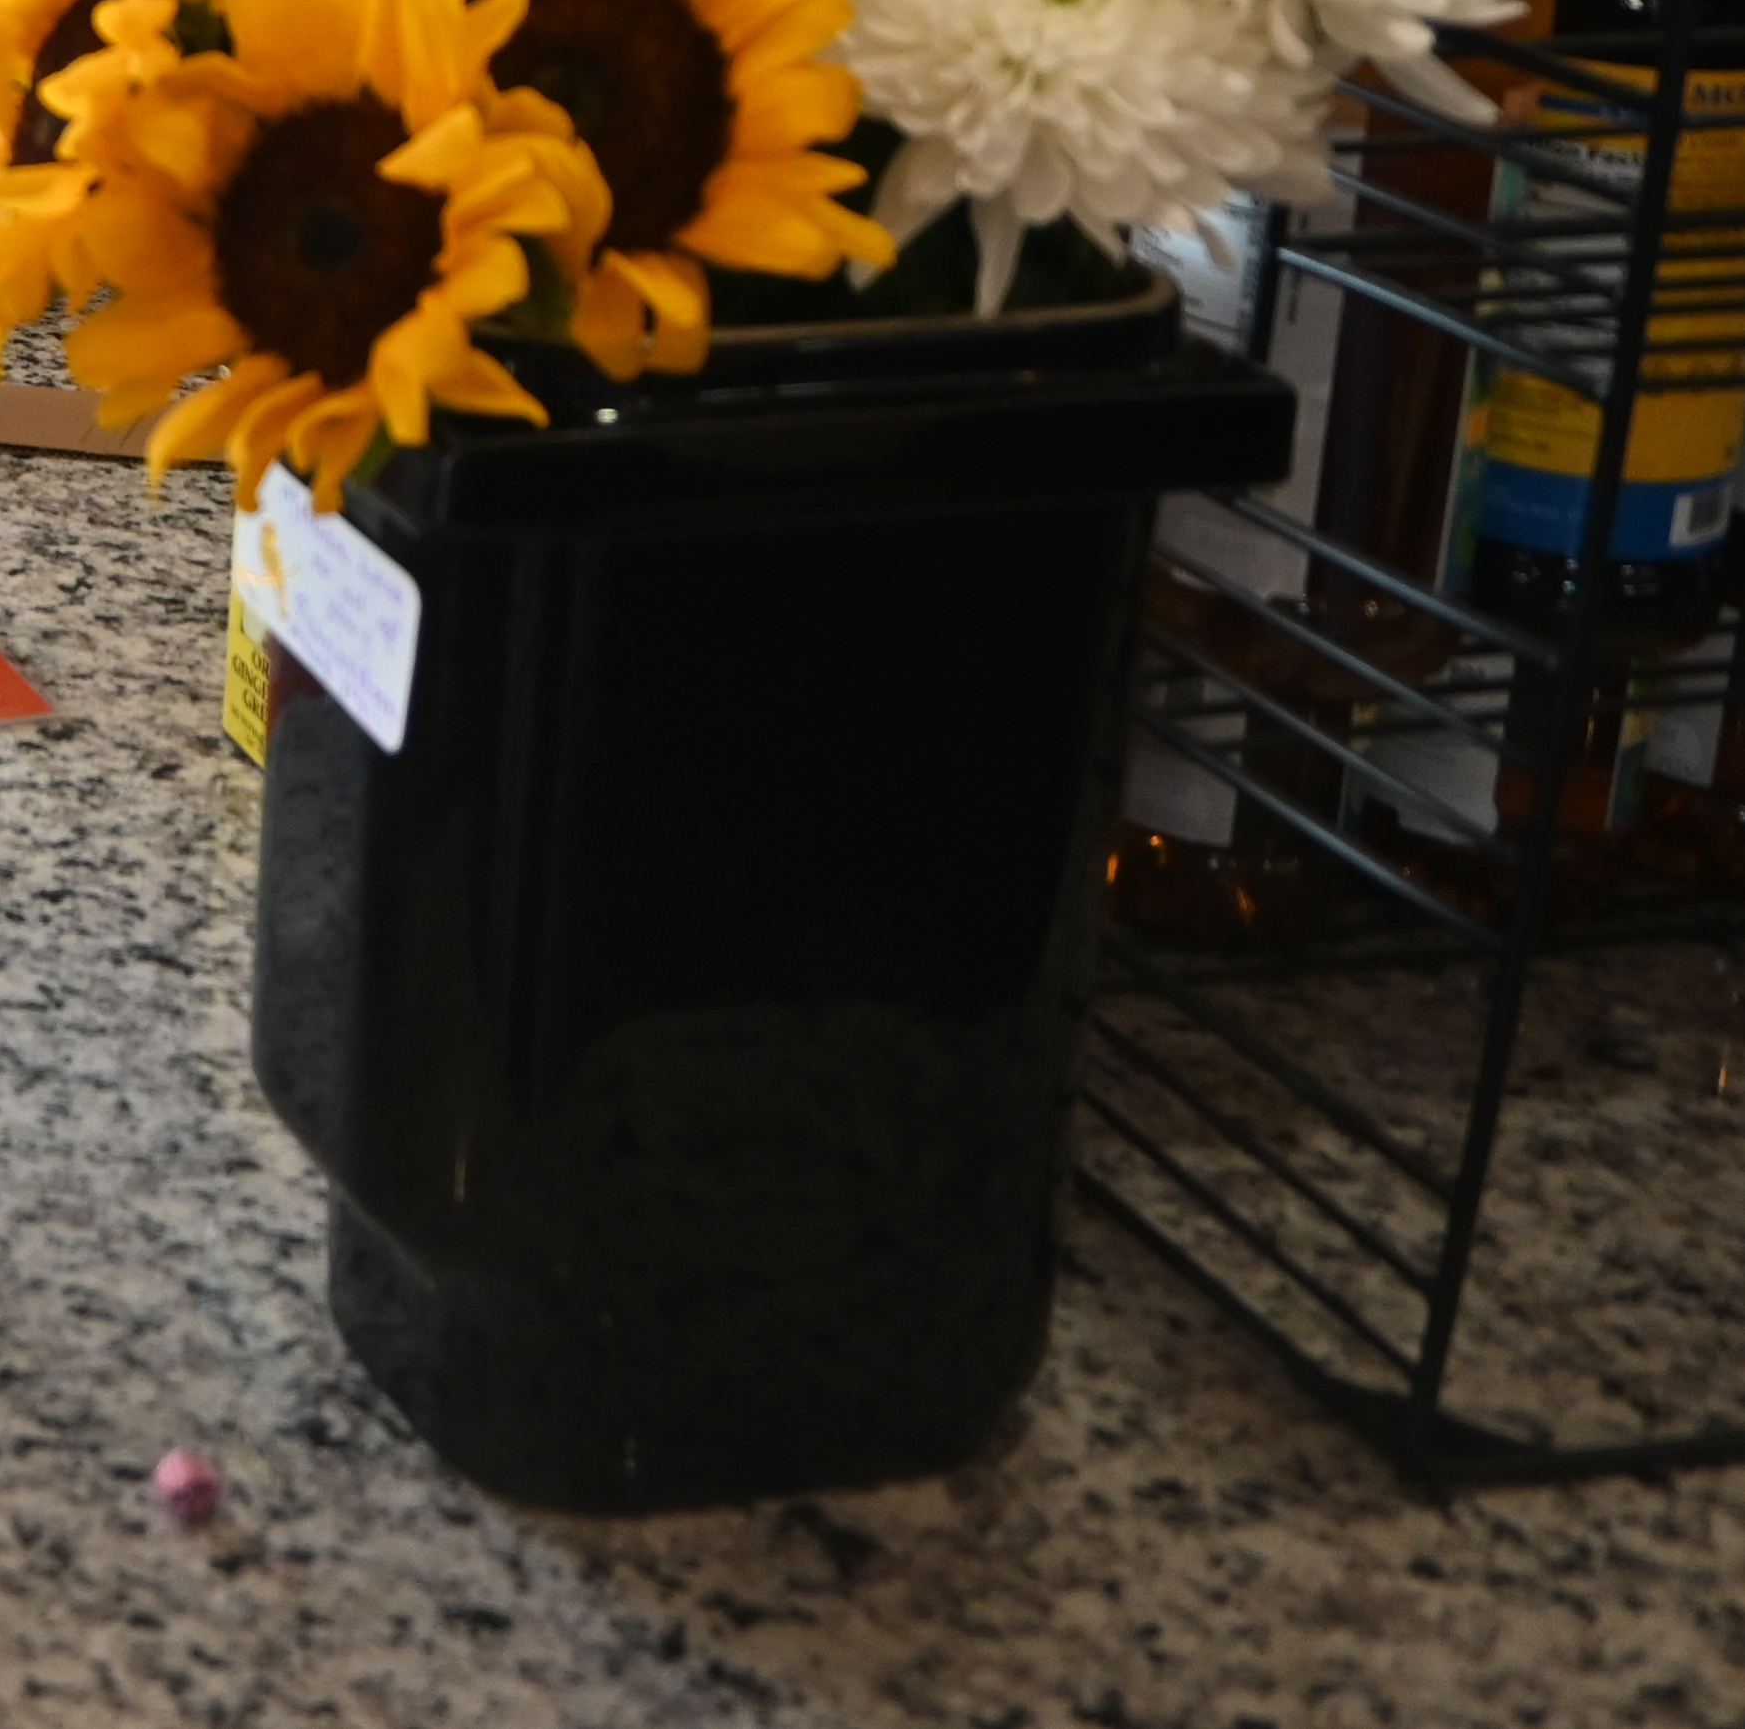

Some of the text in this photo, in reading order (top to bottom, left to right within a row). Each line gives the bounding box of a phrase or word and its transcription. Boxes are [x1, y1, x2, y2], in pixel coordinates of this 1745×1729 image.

[232, 655, 270, 701] GINGE
[251, 647, 270, 676] OR
[242, 688, 268, 723] GRE
